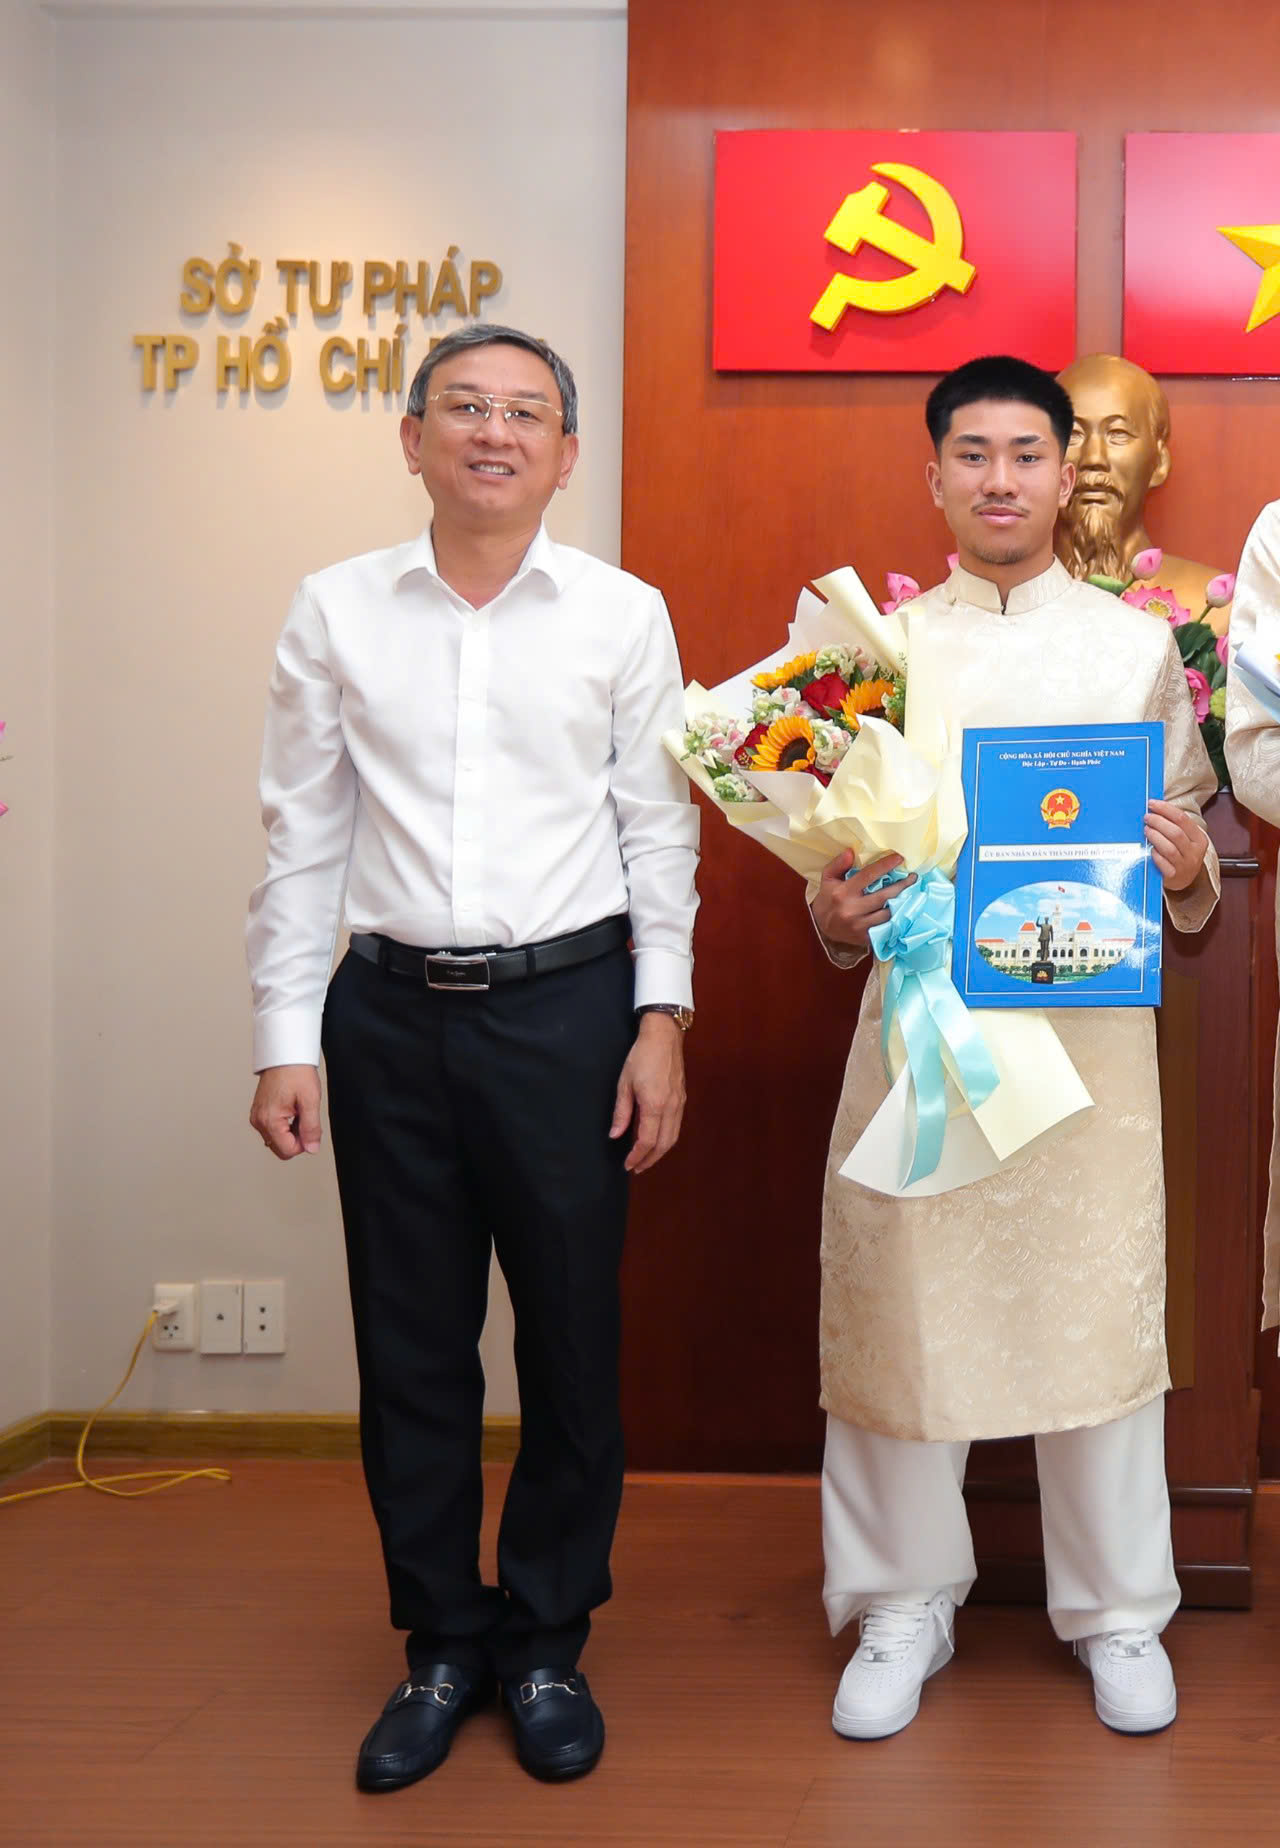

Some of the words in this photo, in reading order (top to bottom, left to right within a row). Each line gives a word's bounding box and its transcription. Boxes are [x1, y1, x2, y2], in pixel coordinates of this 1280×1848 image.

[180, 242, 261, 315] SỞ
[276, 260, 352, 316] TƯ
[363, 245, 503, 317] PHÁP
[133, 334, 199, 392] TP
[216, 317, 292, 393] HỒ
[319, 323, 409, 393] CHÍ
